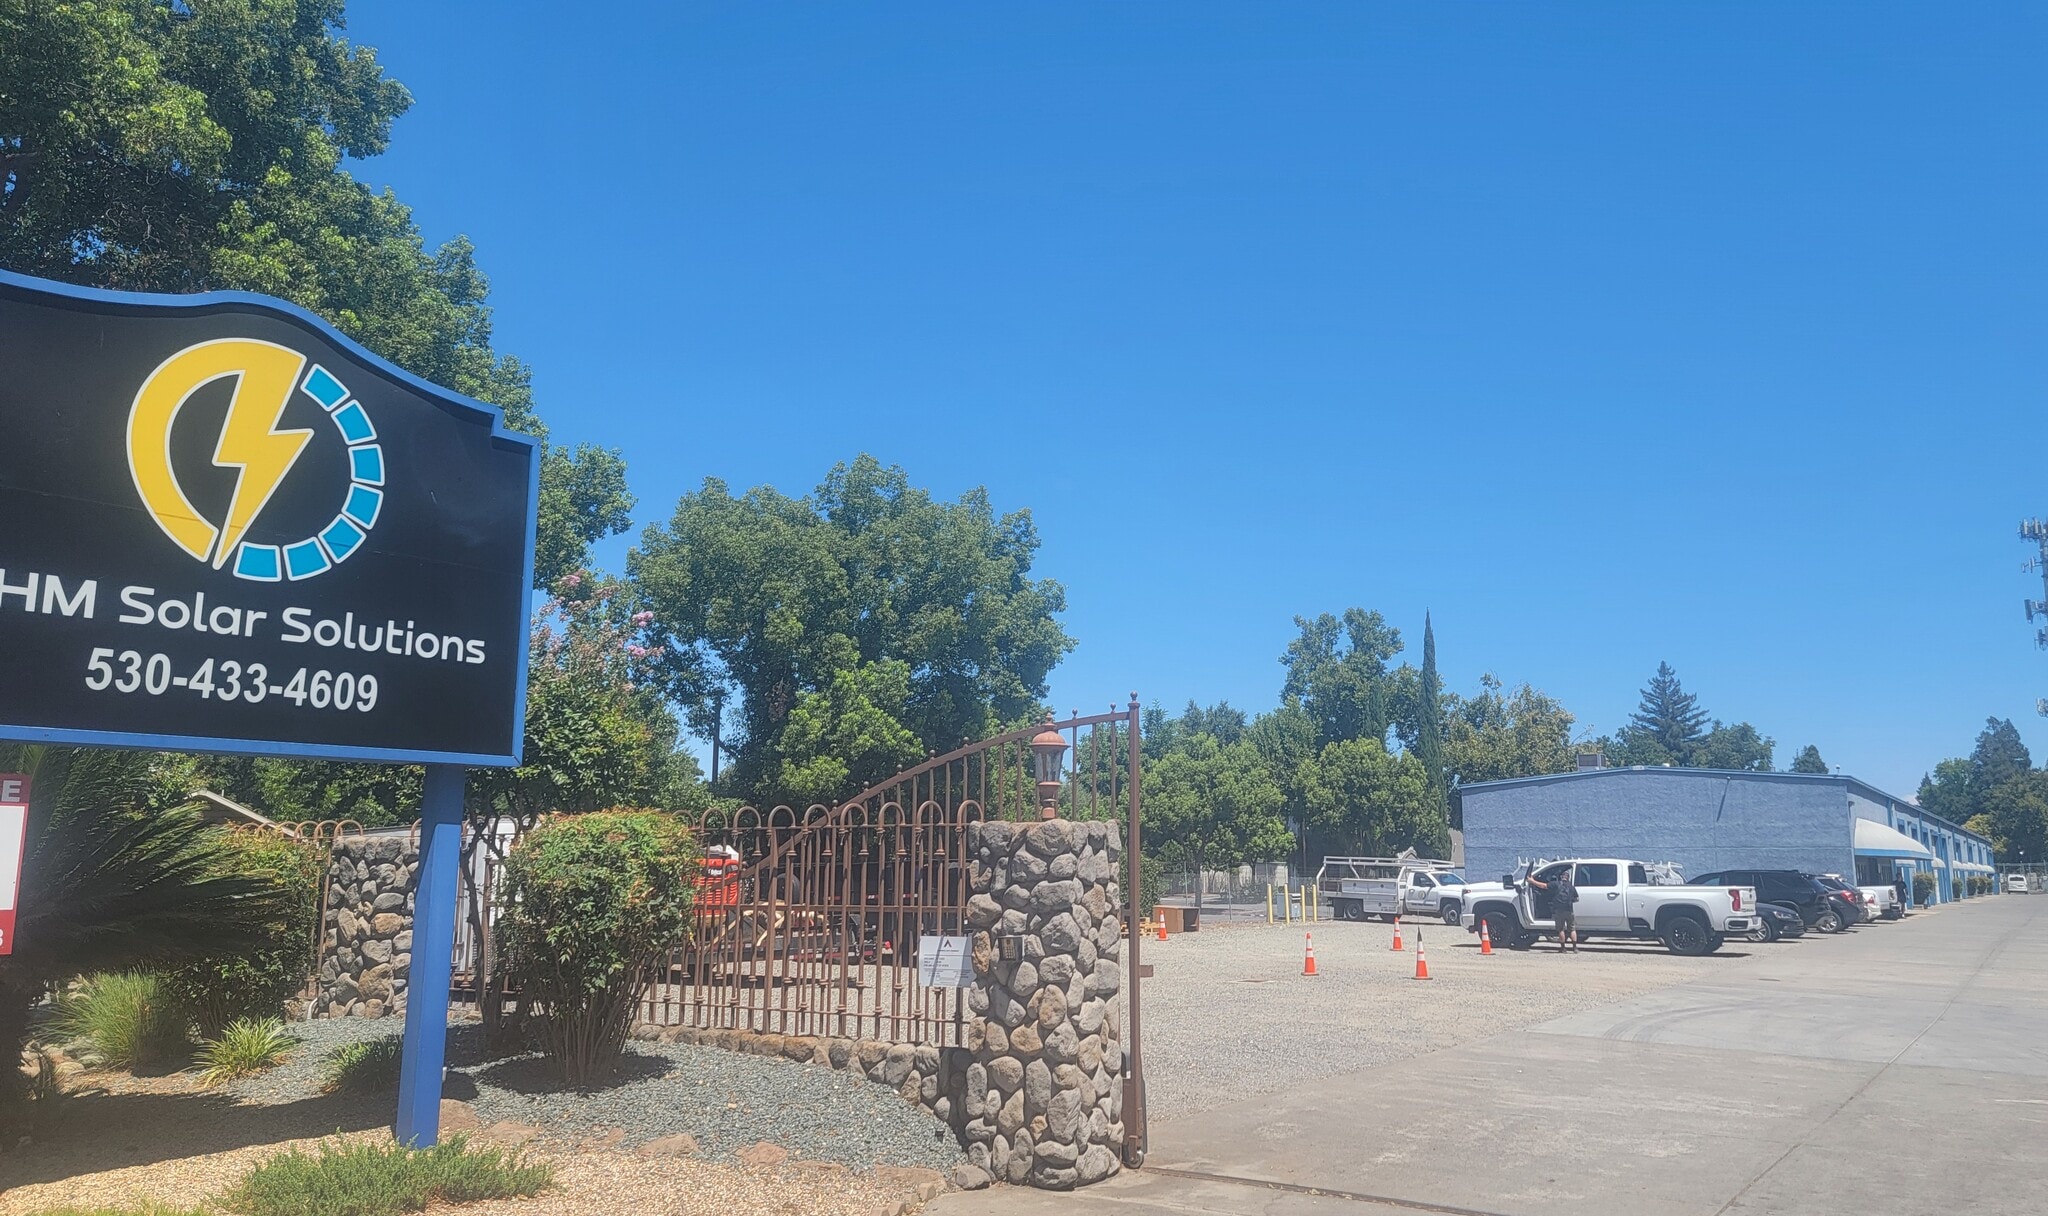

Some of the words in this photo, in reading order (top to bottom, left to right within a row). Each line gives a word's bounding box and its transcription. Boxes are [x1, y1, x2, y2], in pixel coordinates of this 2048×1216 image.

[118, 586, 268, 637] Solar
[280, 606, 487, 665] Solutions
[85, 647, 379, 713] 530-433-4609
